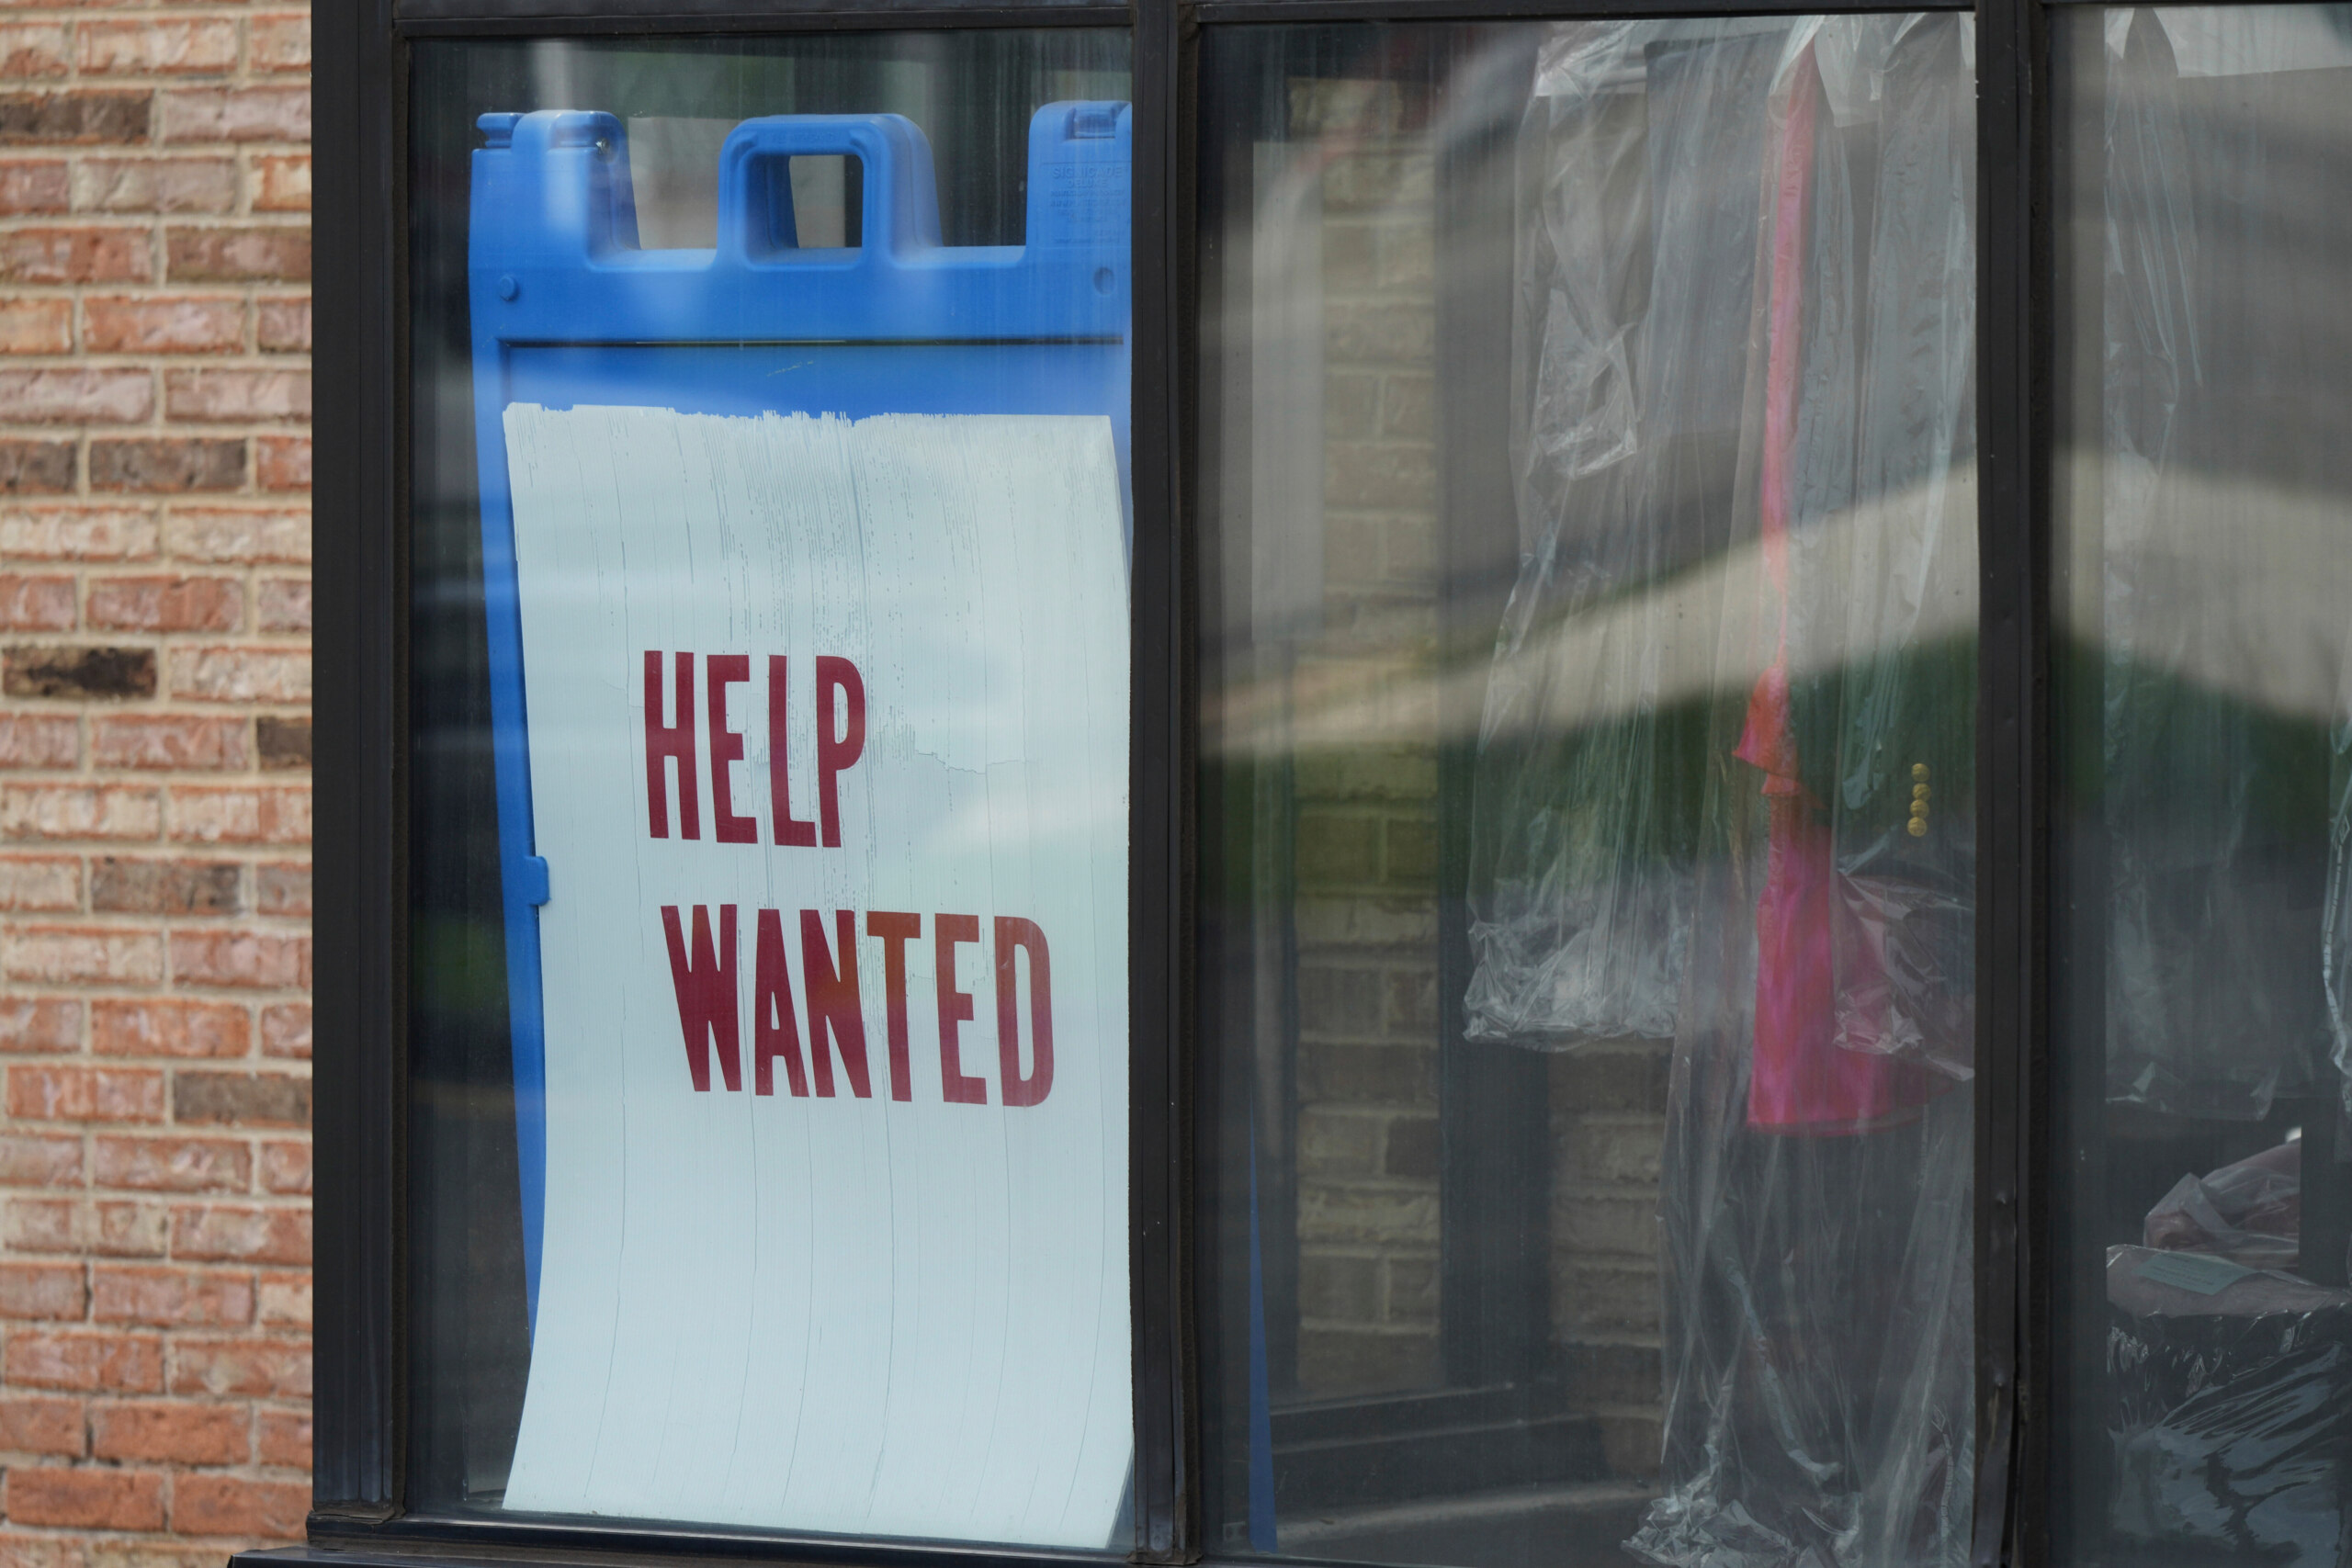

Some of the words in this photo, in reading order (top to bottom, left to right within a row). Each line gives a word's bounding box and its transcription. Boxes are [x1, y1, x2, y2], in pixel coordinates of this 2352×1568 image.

[1067, 177, 1108, 188] DELUXE
[644, 650, 866, 848] HELP
[661, 904, 1055, 1108] WANTED
